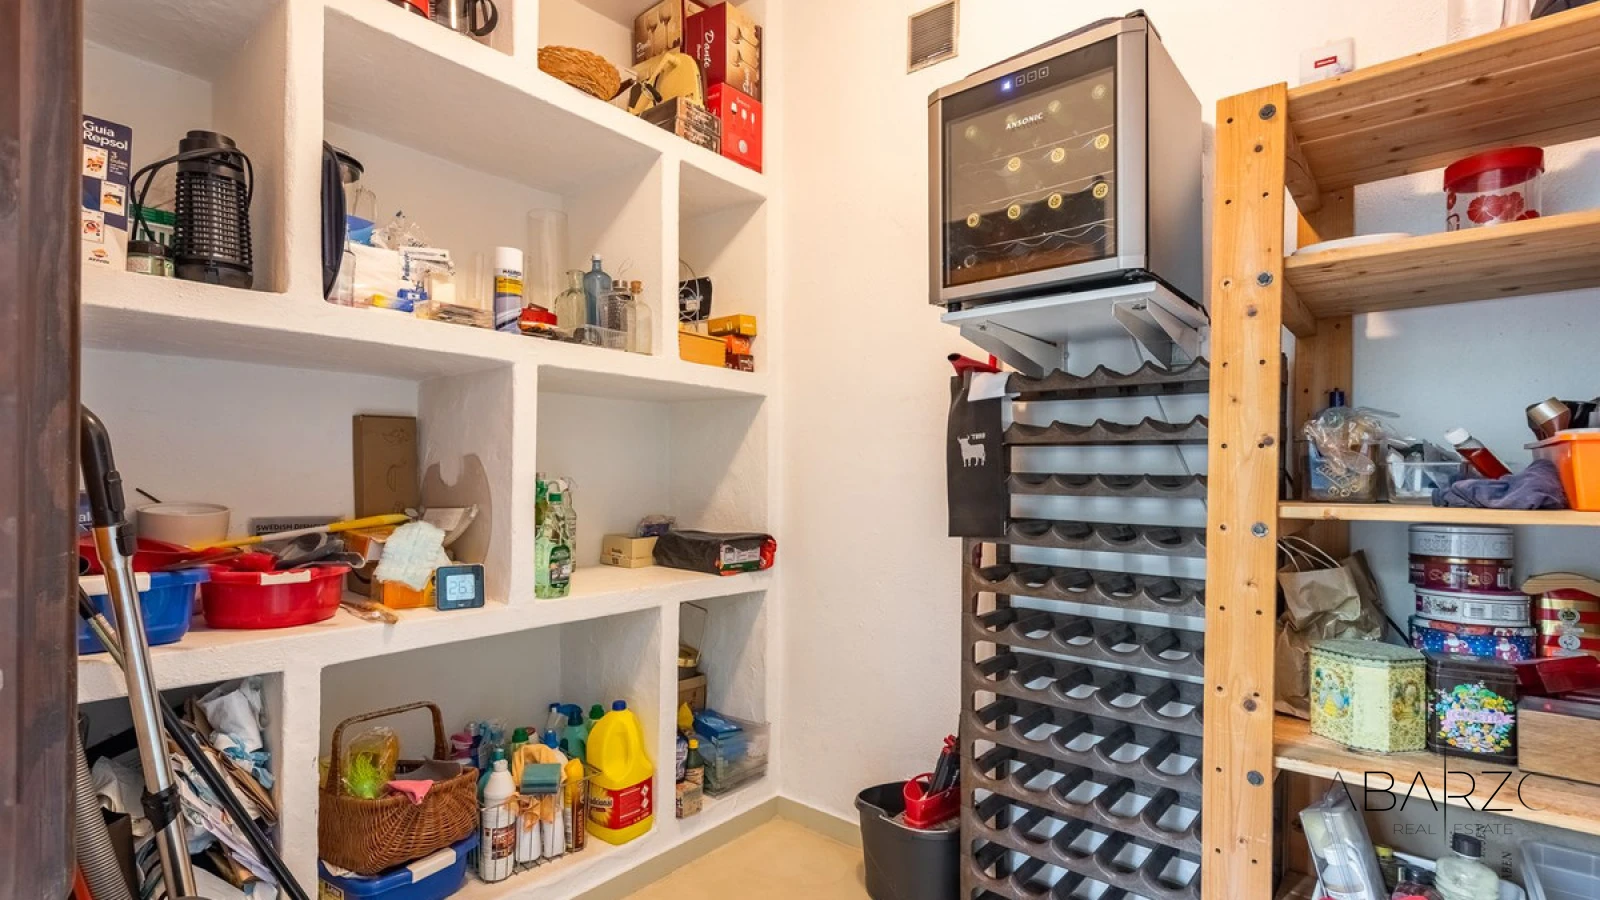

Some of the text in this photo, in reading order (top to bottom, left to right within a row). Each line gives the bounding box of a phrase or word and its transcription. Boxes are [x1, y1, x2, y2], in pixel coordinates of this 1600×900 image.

[703, 30, 715, 68] Dante
[1005, 112, 1043, 130] ANSONIC
[83, 130, 128, 151] Repsol
[255, 524, 293, 532] SWEDISH
